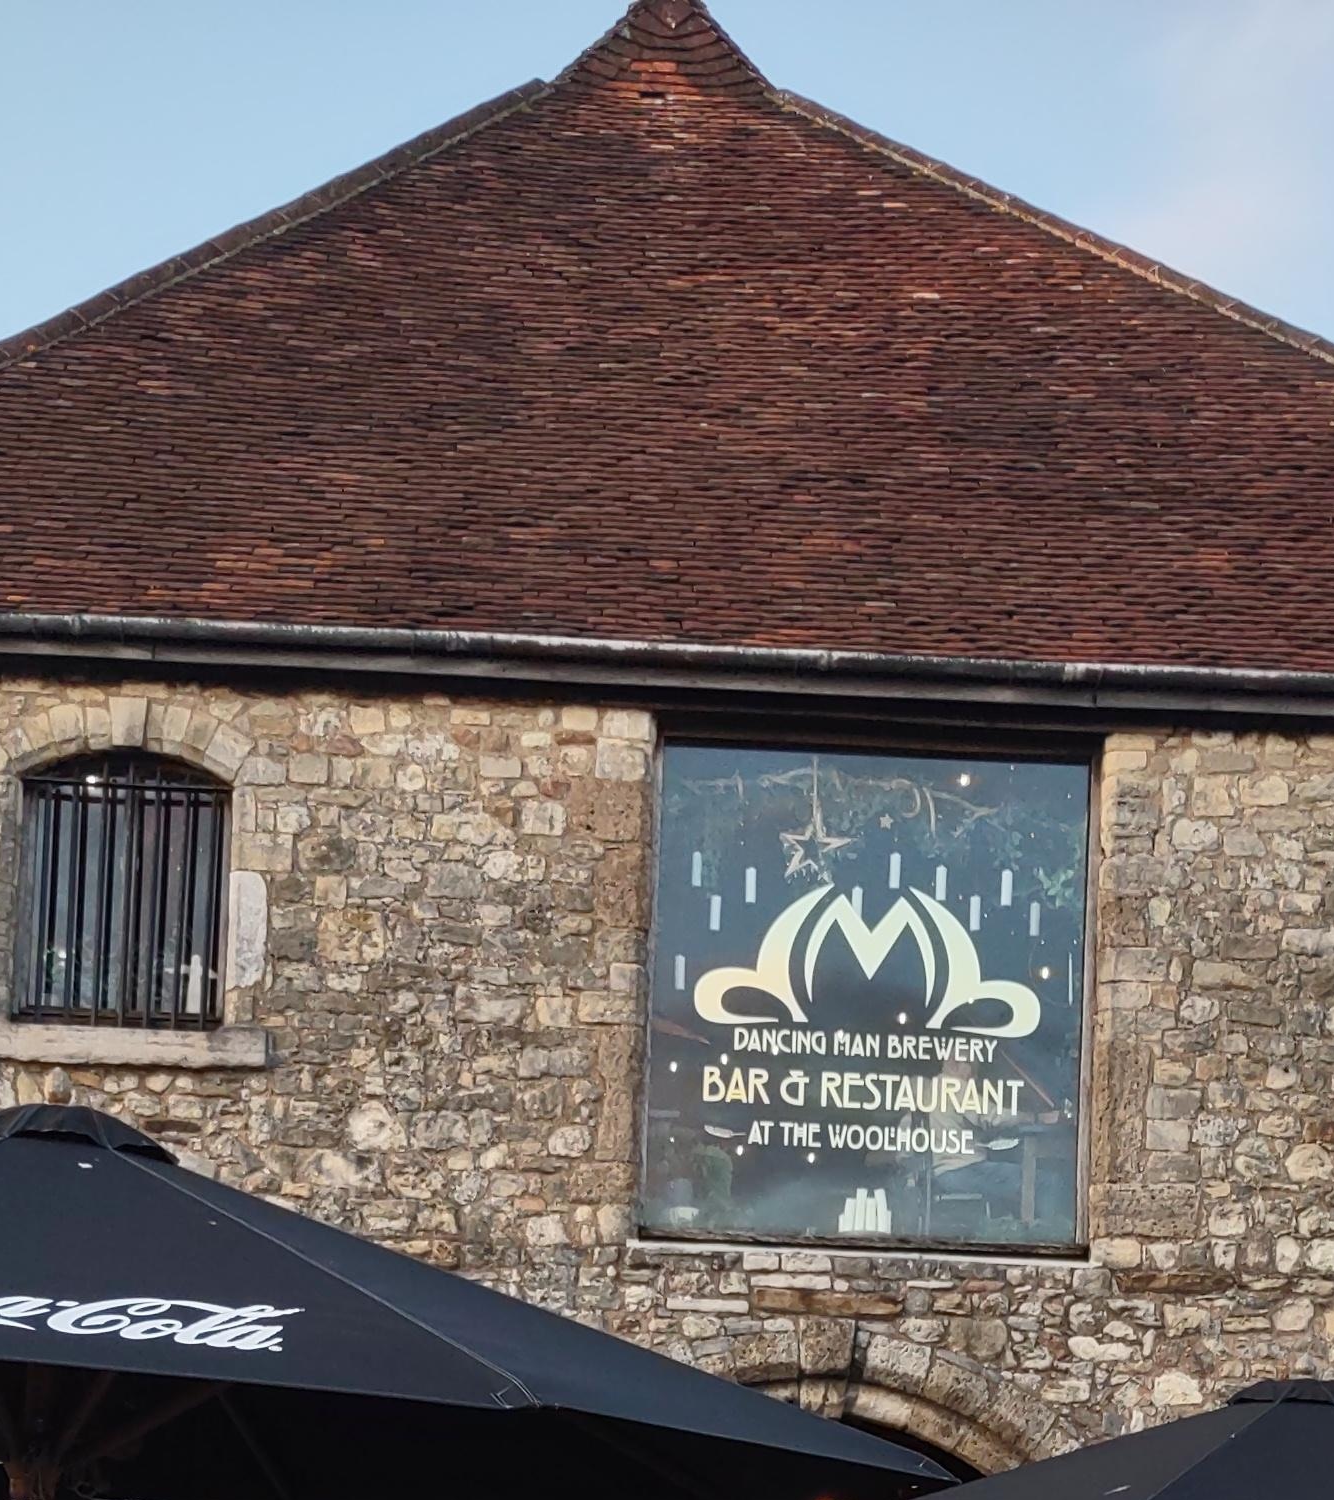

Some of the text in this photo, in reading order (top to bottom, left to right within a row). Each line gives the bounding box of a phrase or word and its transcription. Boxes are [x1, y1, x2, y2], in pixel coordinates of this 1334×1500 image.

[733, 1026, 998, 1063] DANCING MAN BREWERY
[702, 1065, 1025, 1116] BAR & RESTAURANT
[747, 1120, 975, 1155] AT THE WOOLHOUSE
